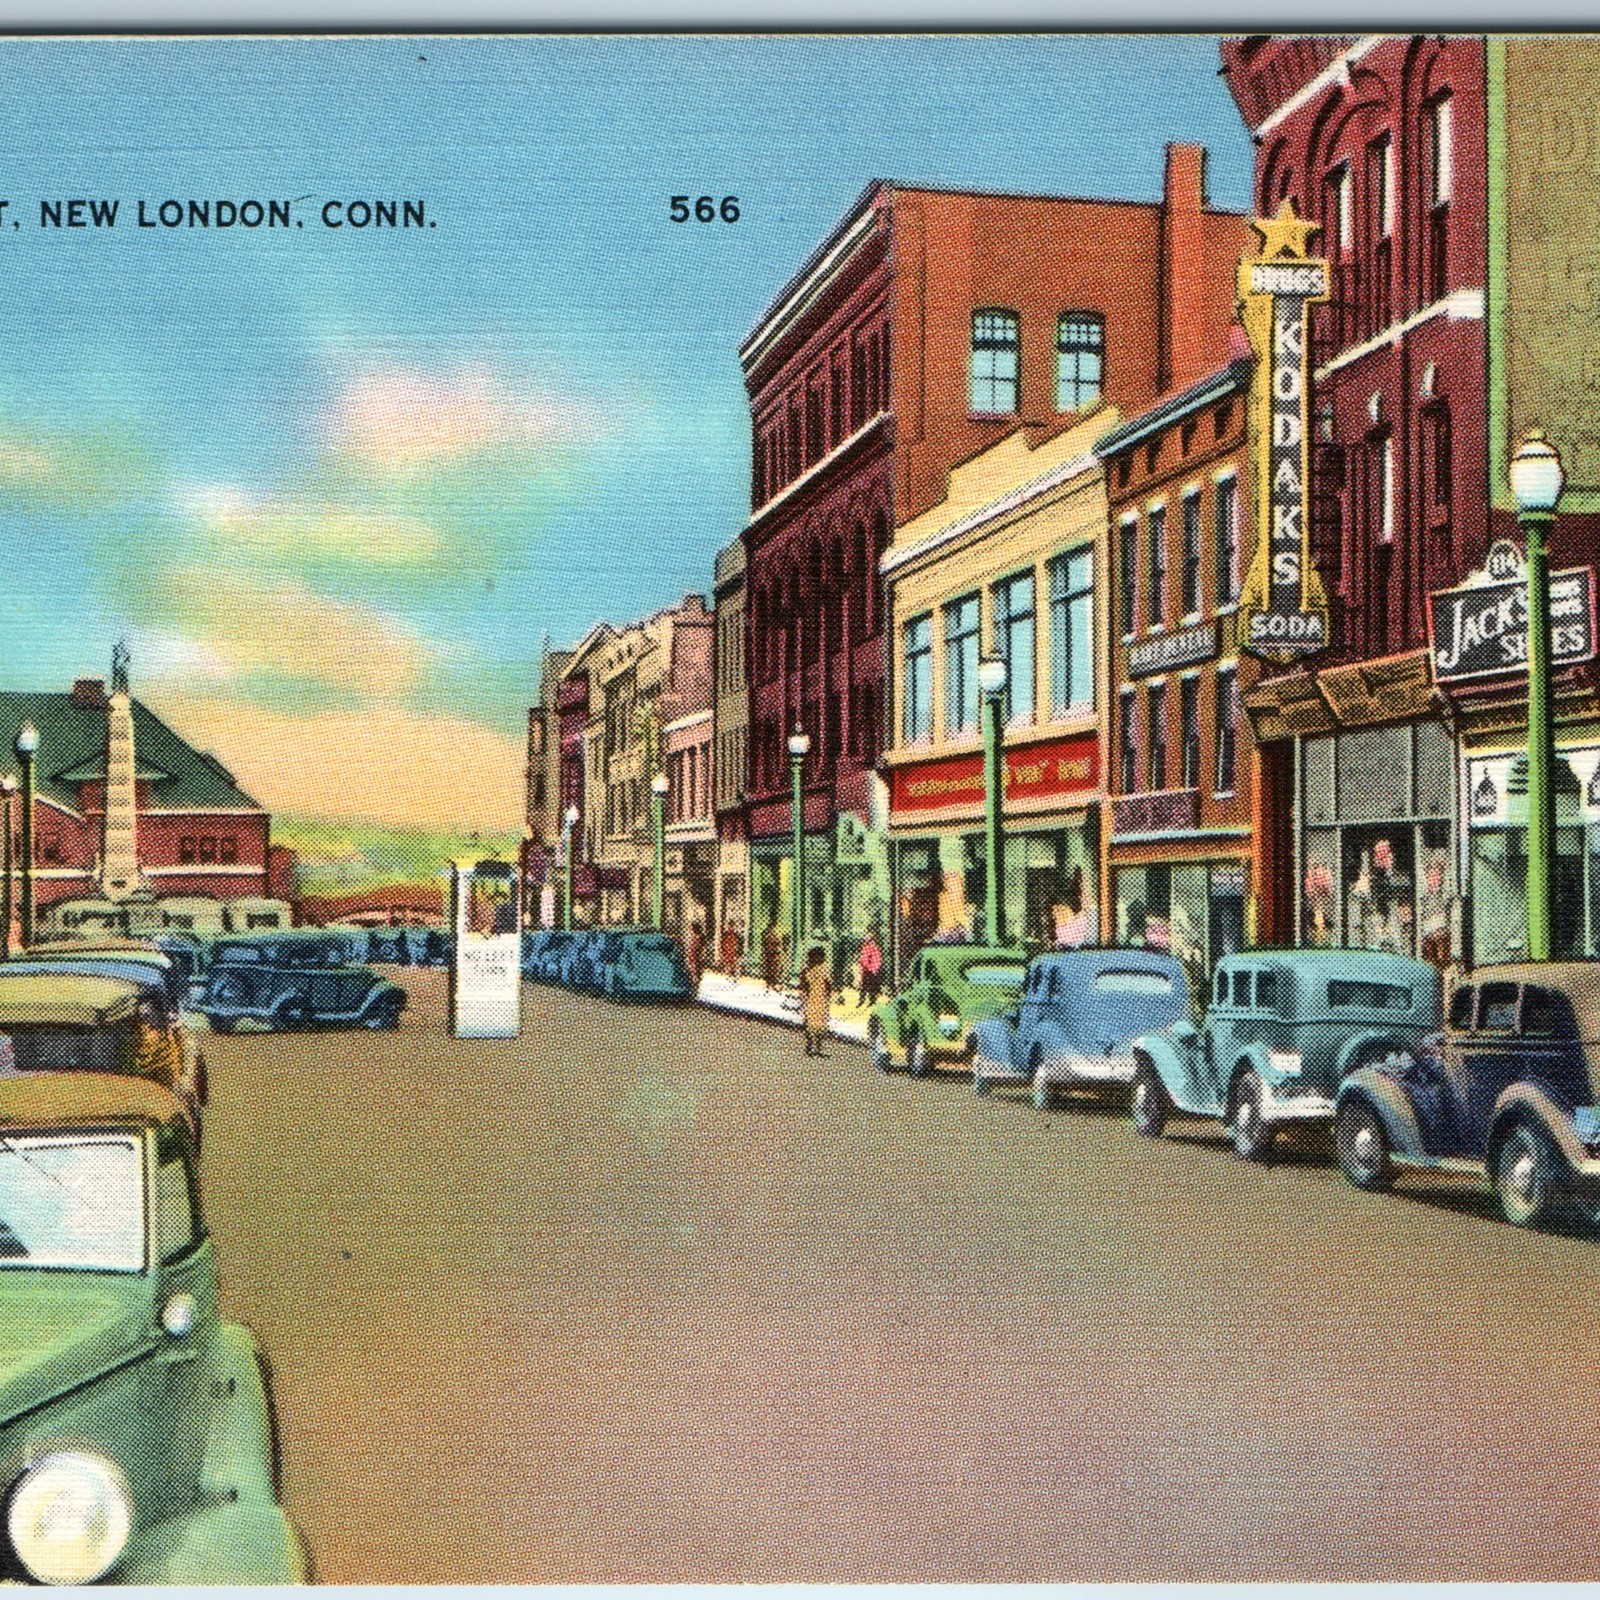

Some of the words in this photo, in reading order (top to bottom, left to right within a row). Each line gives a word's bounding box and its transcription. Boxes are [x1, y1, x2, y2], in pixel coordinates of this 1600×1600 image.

[1251, 267, 1324, 294] DRUGS
[1273, 321, 1303, 584] KODAKS
[1252, 615, 1323, 637] SODA
